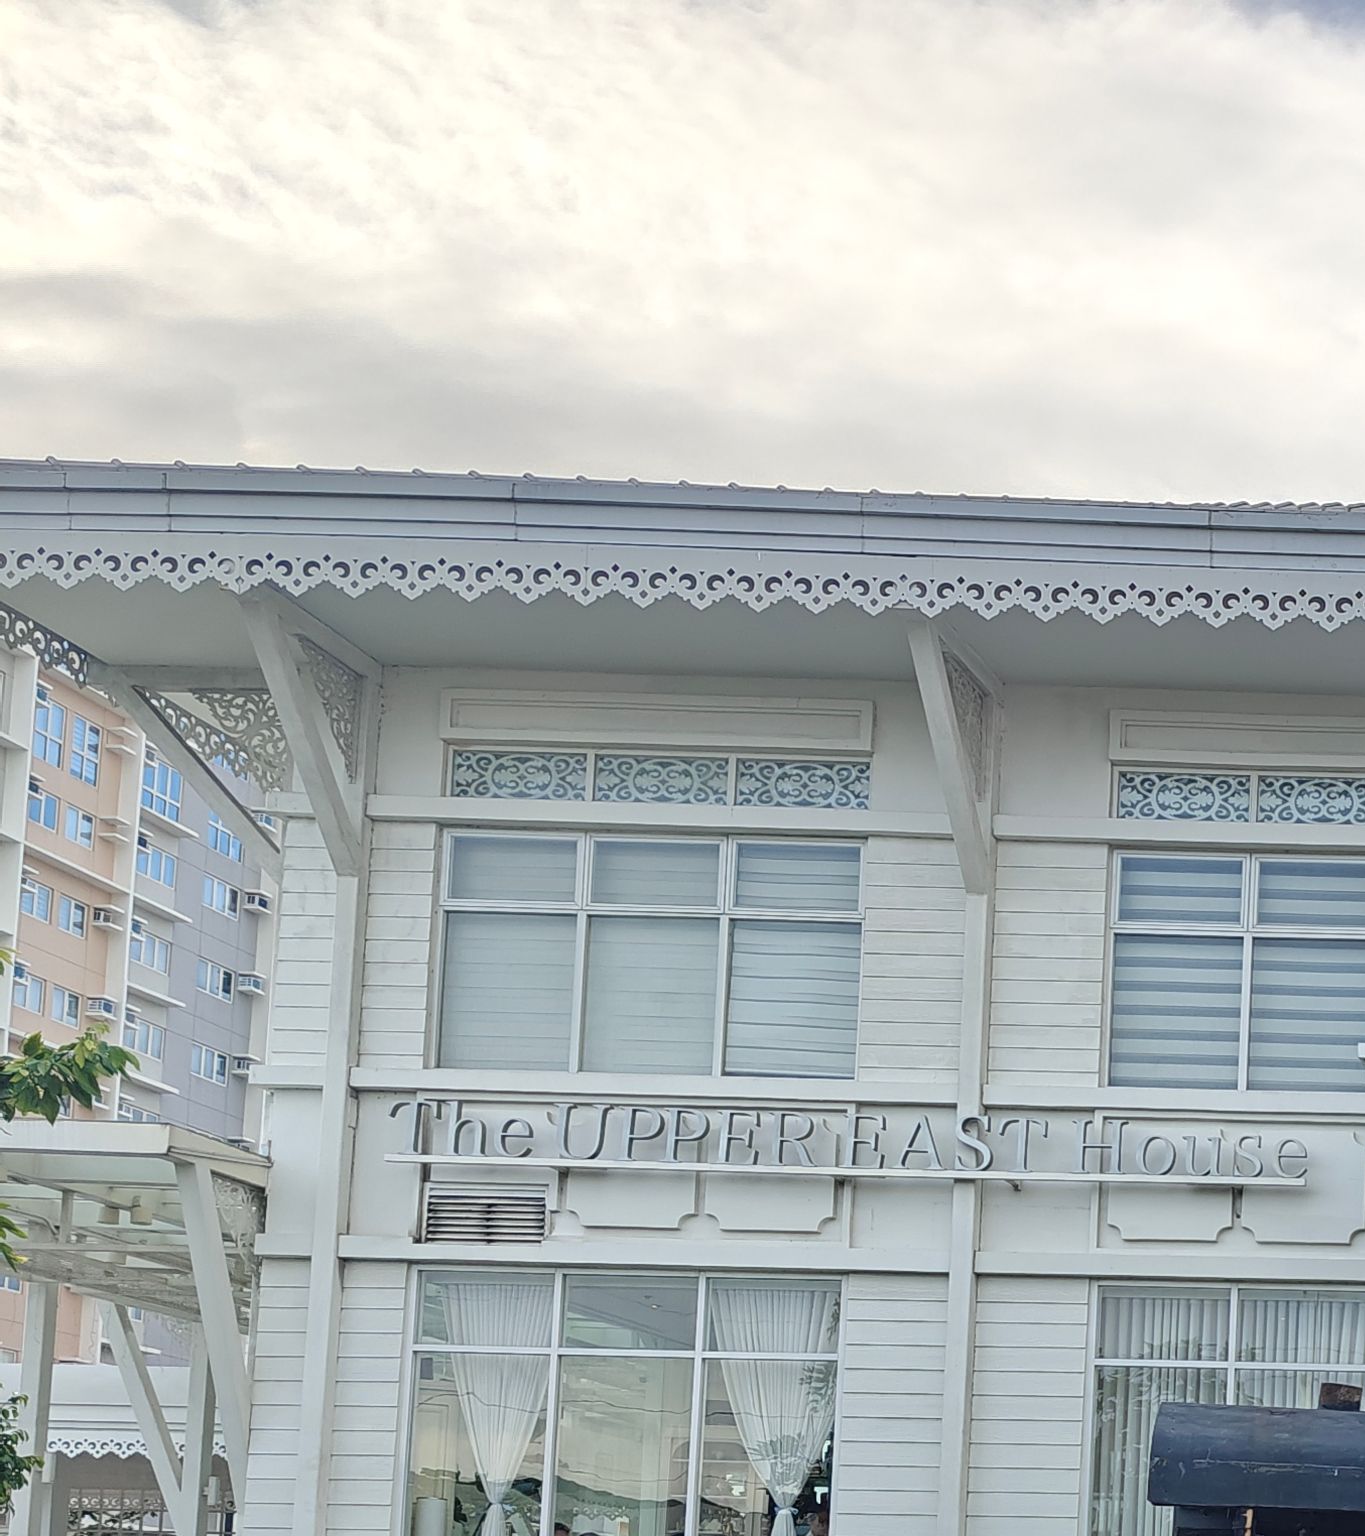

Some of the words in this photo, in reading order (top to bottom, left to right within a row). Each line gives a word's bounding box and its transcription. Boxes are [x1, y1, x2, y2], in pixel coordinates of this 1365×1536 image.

[388, 1099, 534, 1158] The
[547, 1102, 817, 1167] UPPER
[822, 1111, 1048, 1174] EAST
[1072, 1118, 1309, 1179] House
